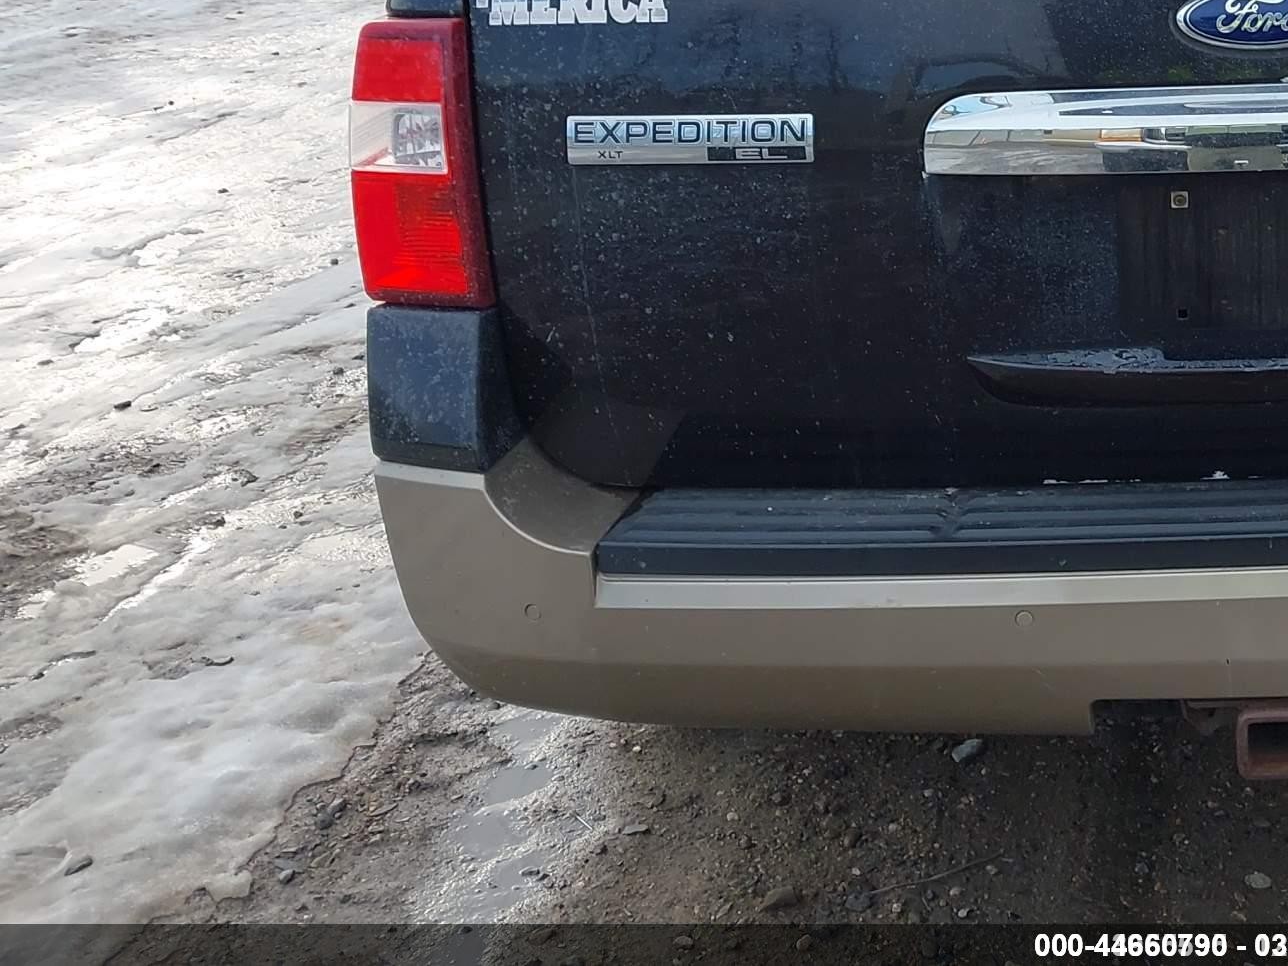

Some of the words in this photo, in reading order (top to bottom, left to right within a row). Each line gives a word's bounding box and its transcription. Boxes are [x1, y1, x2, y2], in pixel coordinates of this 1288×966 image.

[573, 118, 806, 146] EXPEDITION
[598, 150, 623, 159] XLT
[735, 148, 788, 160] EL
